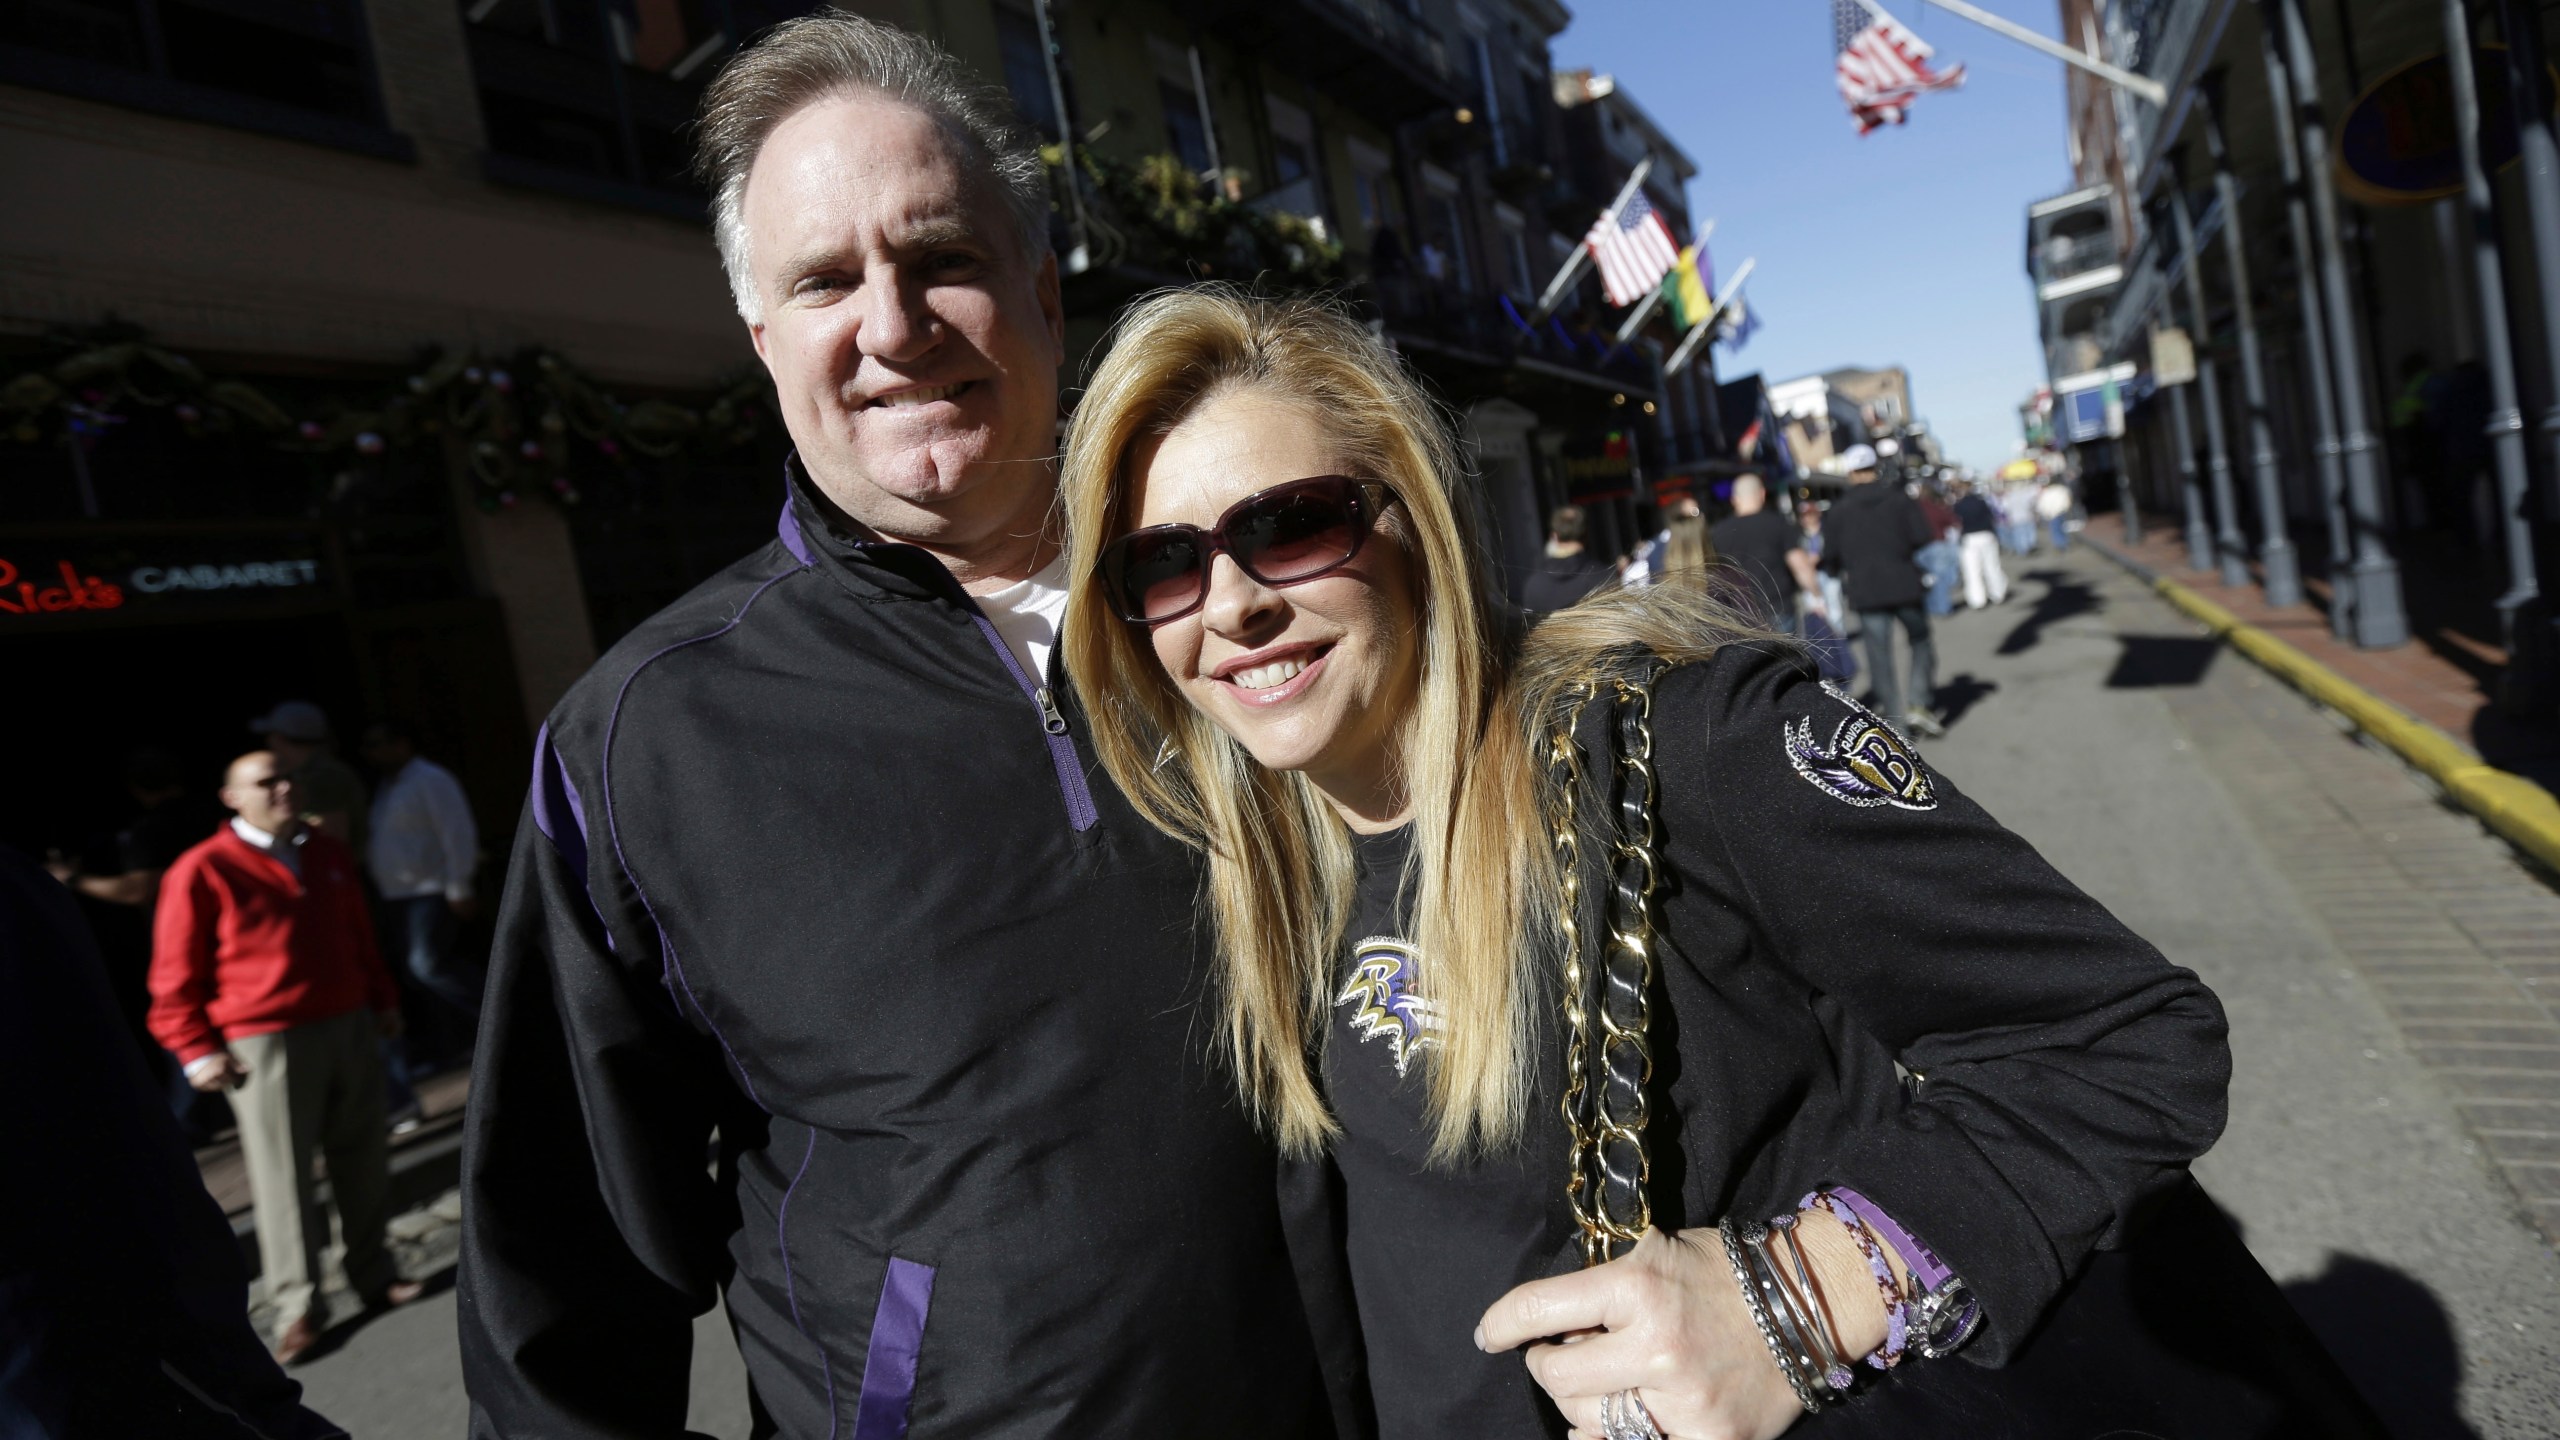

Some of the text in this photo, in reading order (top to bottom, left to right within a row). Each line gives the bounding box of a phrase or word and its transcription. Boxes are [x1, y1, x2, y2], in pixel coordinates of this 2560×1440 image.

[131, 559, 317, 593] CABARET
[1841, 718, 1869, 752] RAVENS
[1842, 733, 1915, 796] B
